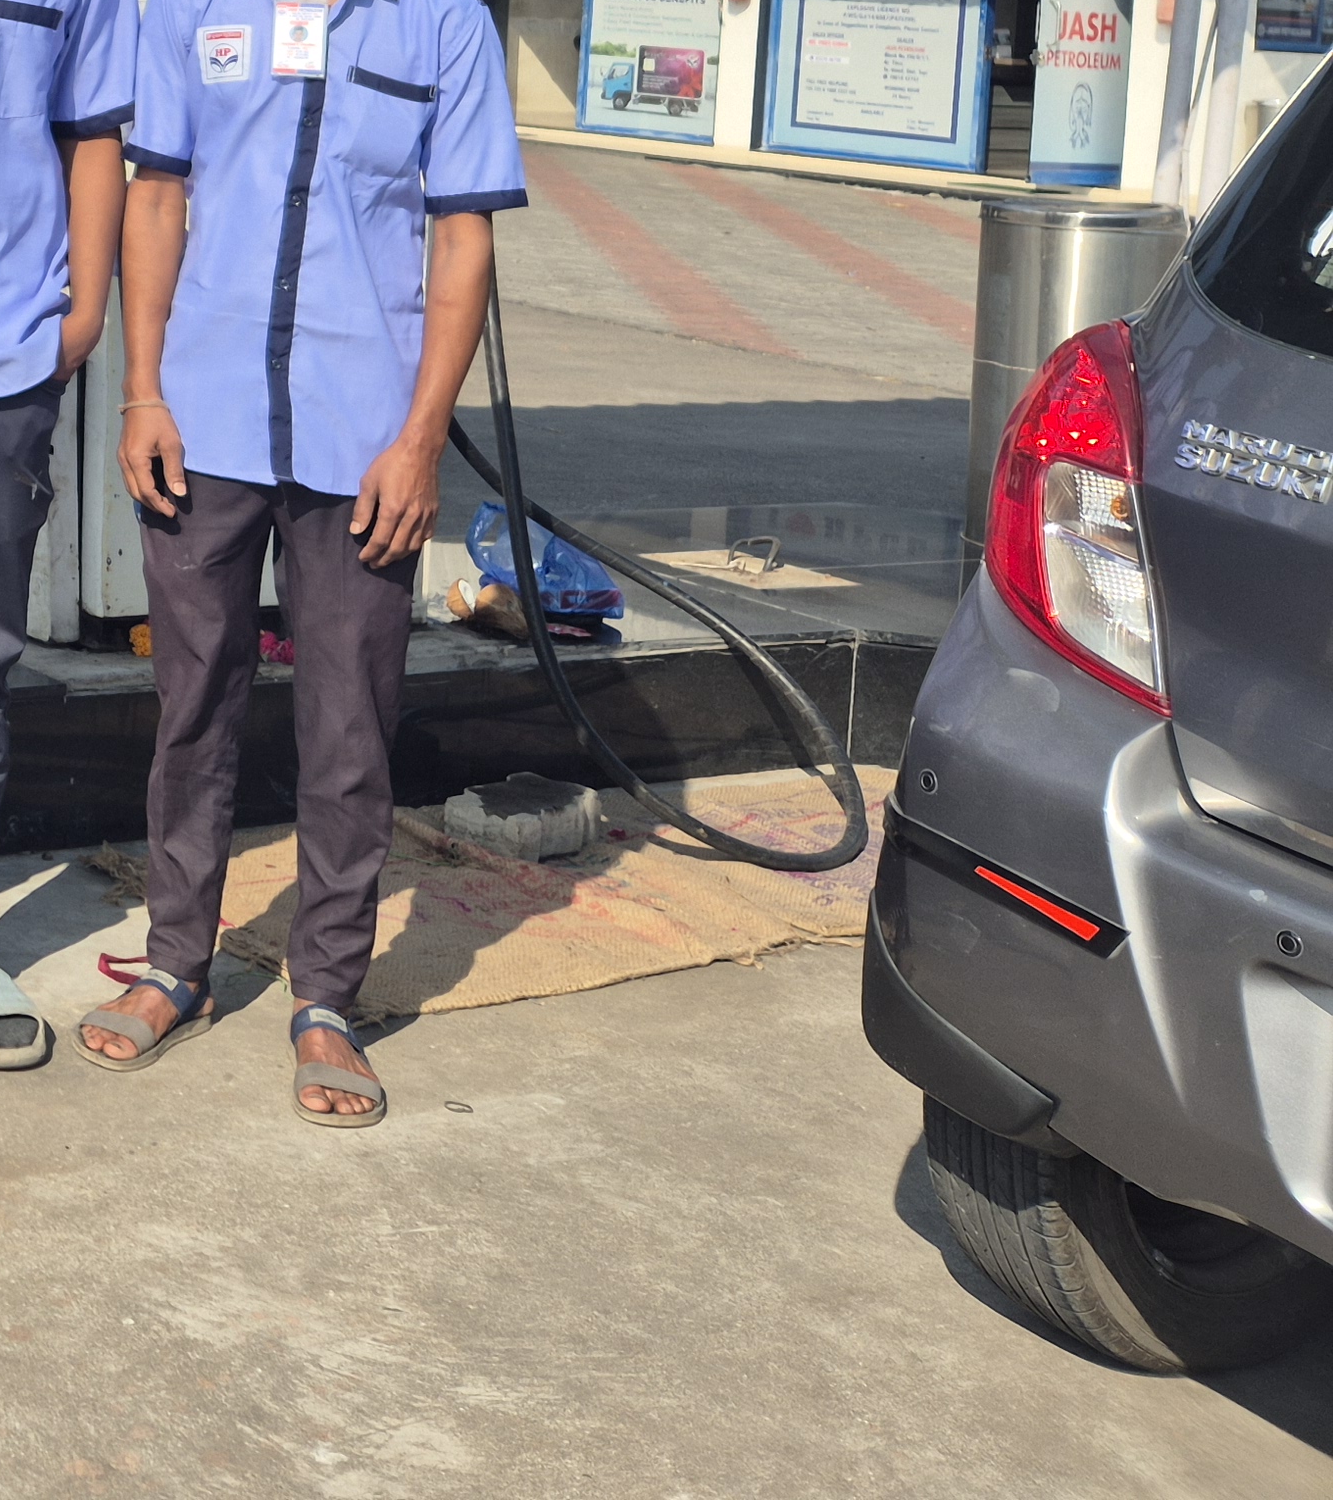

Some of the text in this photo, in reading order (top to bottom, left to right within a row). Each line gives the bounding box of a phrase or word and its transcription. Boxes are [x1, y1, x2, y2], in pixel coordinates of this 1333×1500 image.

[1059, 10, 1118, 43] JASH
[215, 47, 231, 57] HP
[1046, 49, 1122, 71] PETROLEUM
[1174, 443, 1333, 505] SUZUKI
